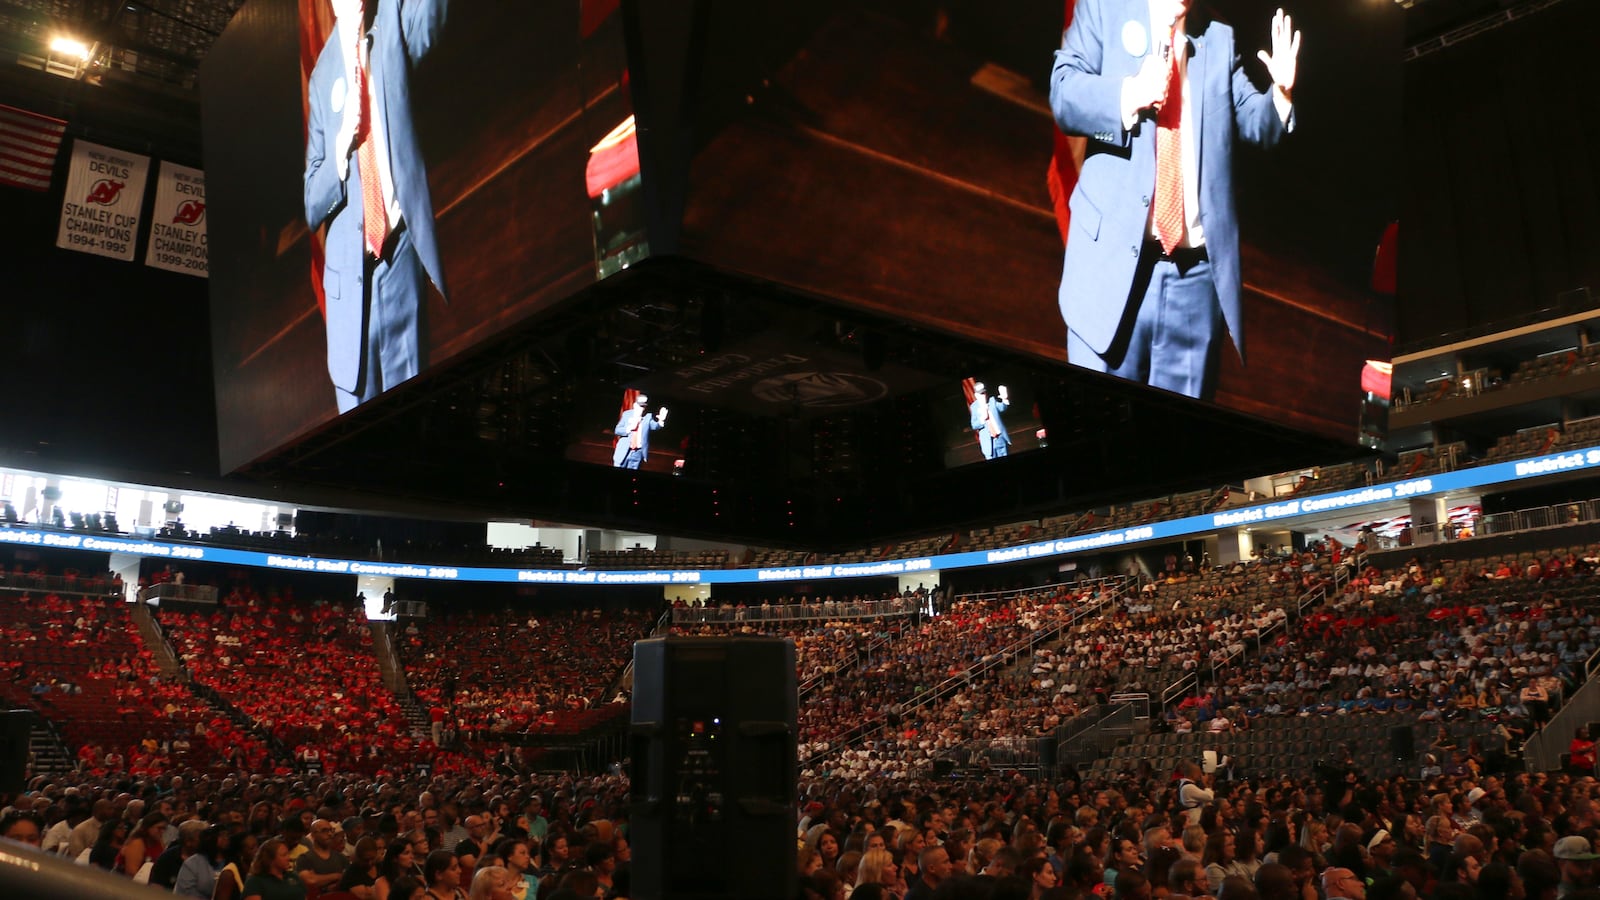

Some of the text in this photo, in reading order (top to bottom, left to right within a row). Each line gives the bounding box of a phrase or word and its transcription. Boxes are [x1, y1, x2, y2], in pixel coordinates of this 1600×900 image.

[89, 161, 129, 179] DEVILS
[176, 182, 205, 198] DEVIL
[64, 203, 136, 228] STANLEY CUP
[66, 218, 131, 242] CHAMPIONS
[153, 223, 199, 243] STANLEY
[67, 233, 126, 253] 1994-1995
[155, 238, 208, 260] CHAMPION
[1515, 453, 1585, 476] District
[1213, 508, 1263, 526] District
[1265, 501, 1299, 518] Staff
[1301, 487, 1393, 512] Convocation
[0, 530, 41, 543] strict
[43, 533, 81, 547] Staff
[83, 537, 170, 556] Convocation
[987, 545, 1027, 562] District
[1028, 542, 1054, 556] Staff
[1055, 533, 1124, 552] Convocation
[267, 556, 314, 570] District
[316, 560, 348, 572] Staff
[350, 562, 427, 577] Convocation
[518, 570, 564, 582] District
[565, 572, 596, 582] Staff
[597, 572, 671, 583] Convocation
[758, 569, 801, 580] District
[803, 566, 832, 578] Staff
[834, 561, 904, 577] Convocation
